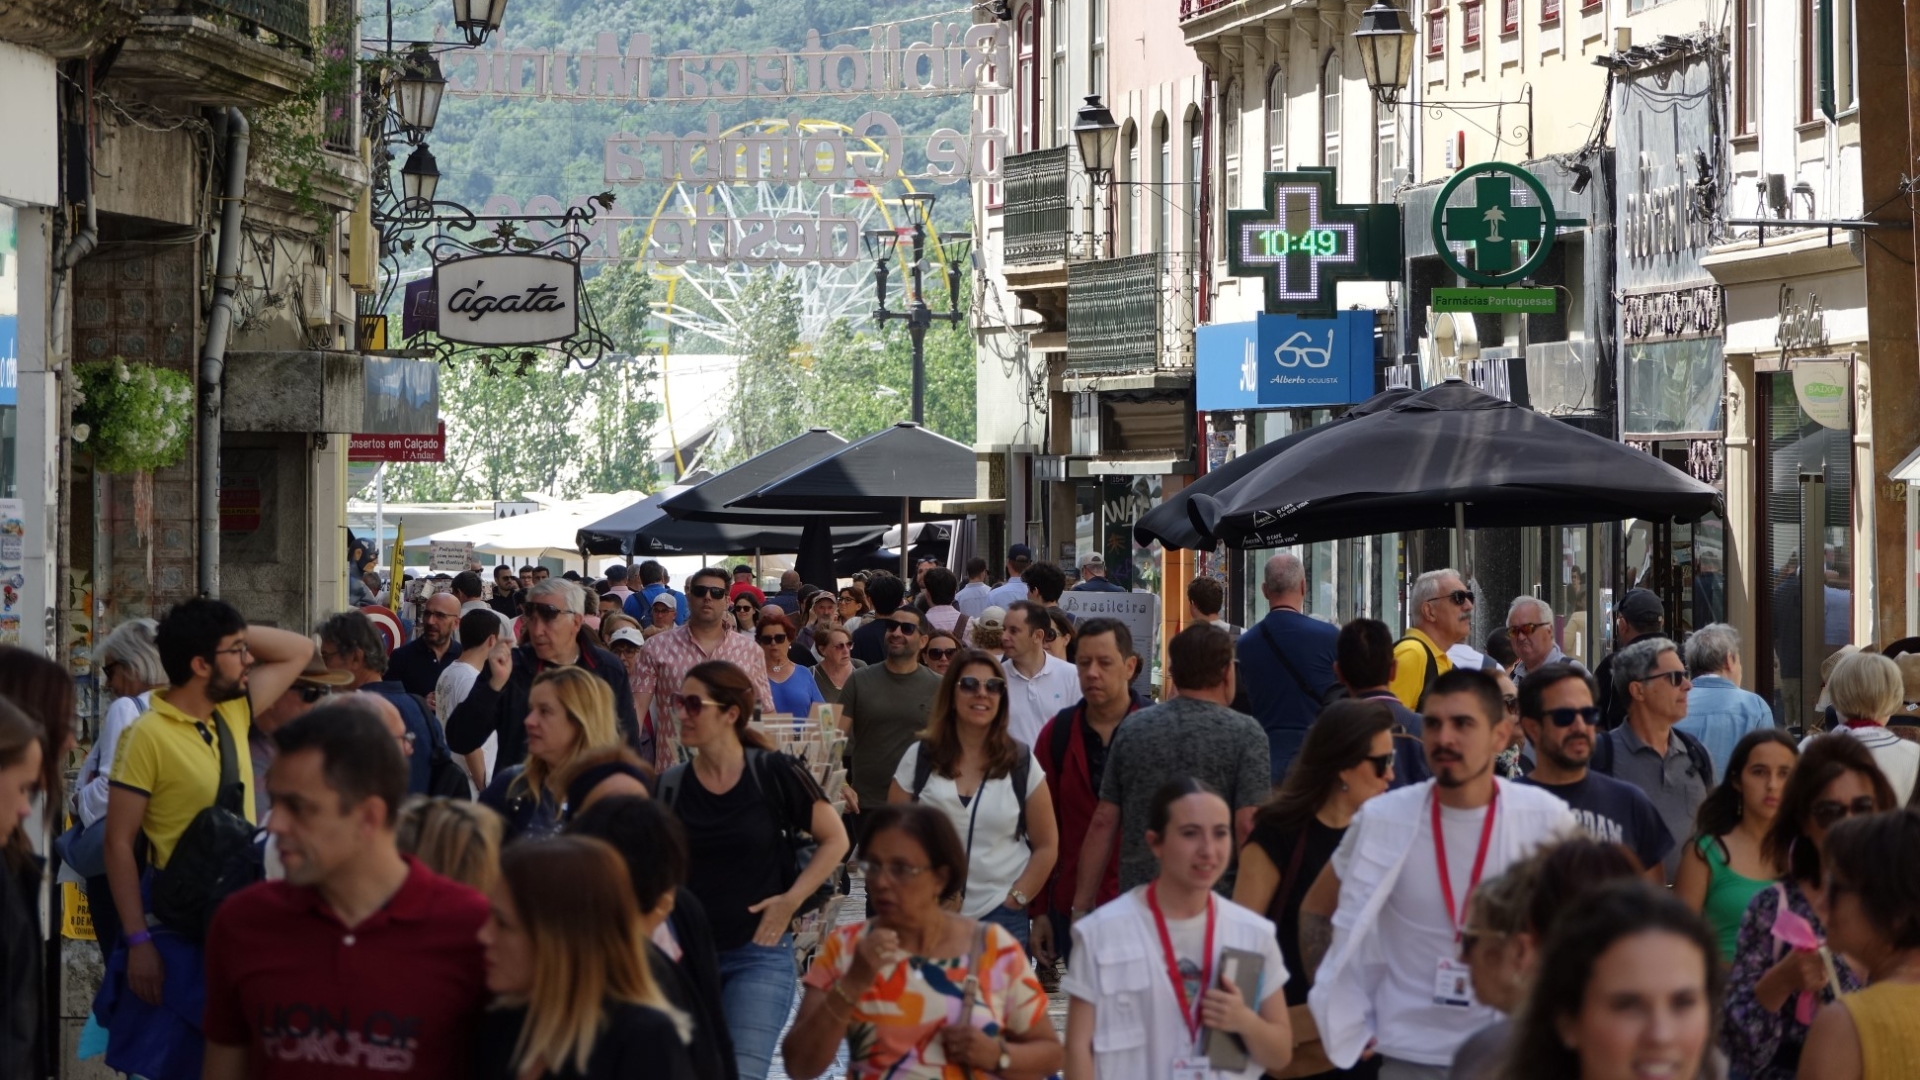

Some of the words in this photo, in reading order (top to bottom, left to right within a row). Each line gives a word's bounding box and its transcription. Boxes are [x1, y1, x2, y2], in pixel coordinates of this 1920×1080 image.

[1258, 229, 1337, 256] 10:49
[1270, 374, 1306, 384] Alberto
[1808, 385, 1838, 394] BAIXA
[388, 441, 401, 449] em
[404, 438, 439, 451] Calçado
[409, 450, 436, 460] Andar
[1286, 507, 1298, 515] SUA
[1296, 500, 1310, 510] VIDA
[1063, 597, 1147, 614] Brasileira
[76, 916, 84, 925] DE
